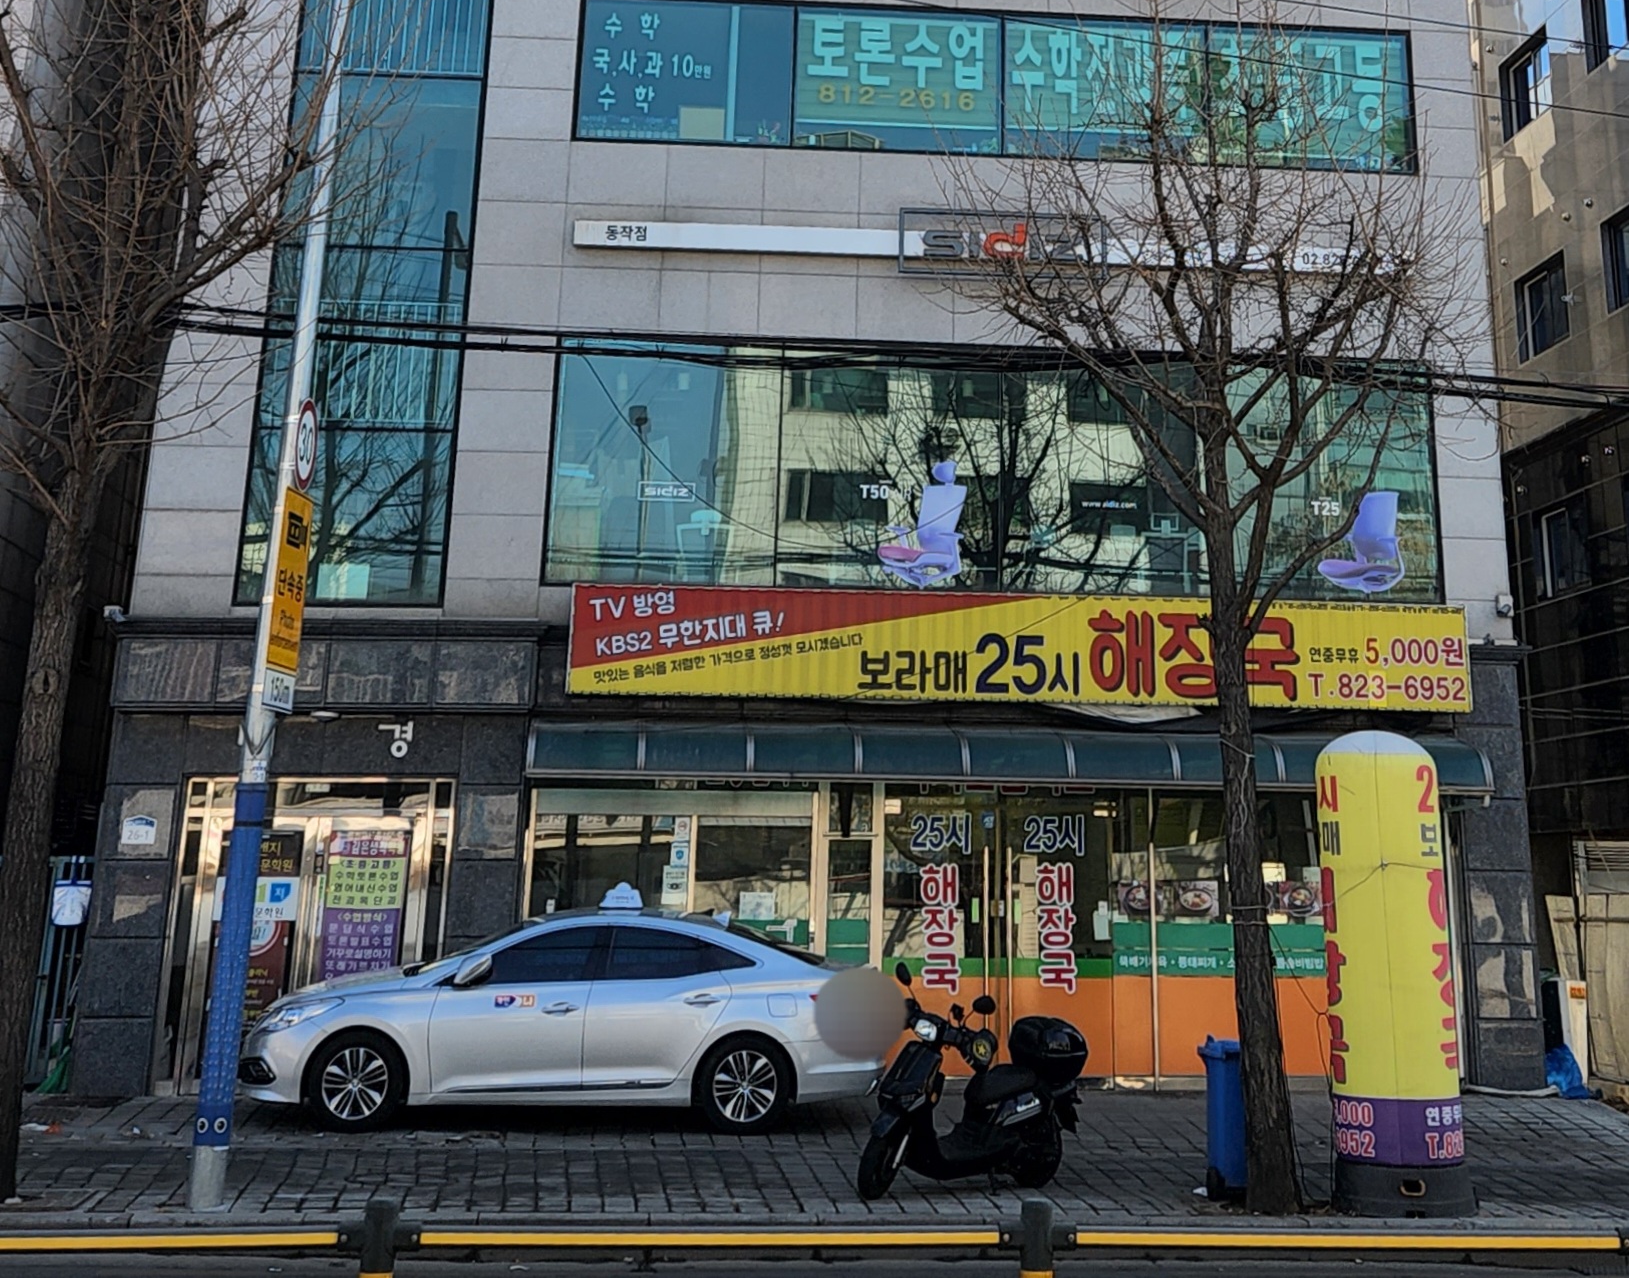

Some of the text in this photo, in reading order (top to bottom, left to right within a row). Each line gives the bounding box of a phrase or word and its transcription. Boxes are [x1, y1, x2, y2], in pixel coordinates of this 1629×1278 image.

[807, 20, 985, 90] 토론수업
[818, 84, 977, 112] 812-2616
[605, 225, 648, 242] 동작점
[299, 423, 313, 465] 30
[860, 484, 889, 499] T50
[1311, 501, 1340, 516] T25
[278, 569, 304, 603] 단속중
[589, 590, 675, 621] TV 방영
[595, 611, 785, 657] KBS2 무한지대 큐!
[1309, 636, 1465, 667] 연중무휴 5,000원
[593, 633, 864, 684] 맛있는 음식을 저렴한 가격으로 정성껏 모시겠습니다
[857, 650, 968, 695] 보라매
[974, 633, 1081, 697] 25시
[1307, 673, 1467, 701] T.823-6952
[378, 720, 414, 758] 경
[127, 830, 150, 841] 26-1
[910, 812, 972, 854] 25시
[1023, 814, 1085, 856] 25시
[920, 863, 960, 996] 해장국
[1036, 862, 1077, 995] 해장국
